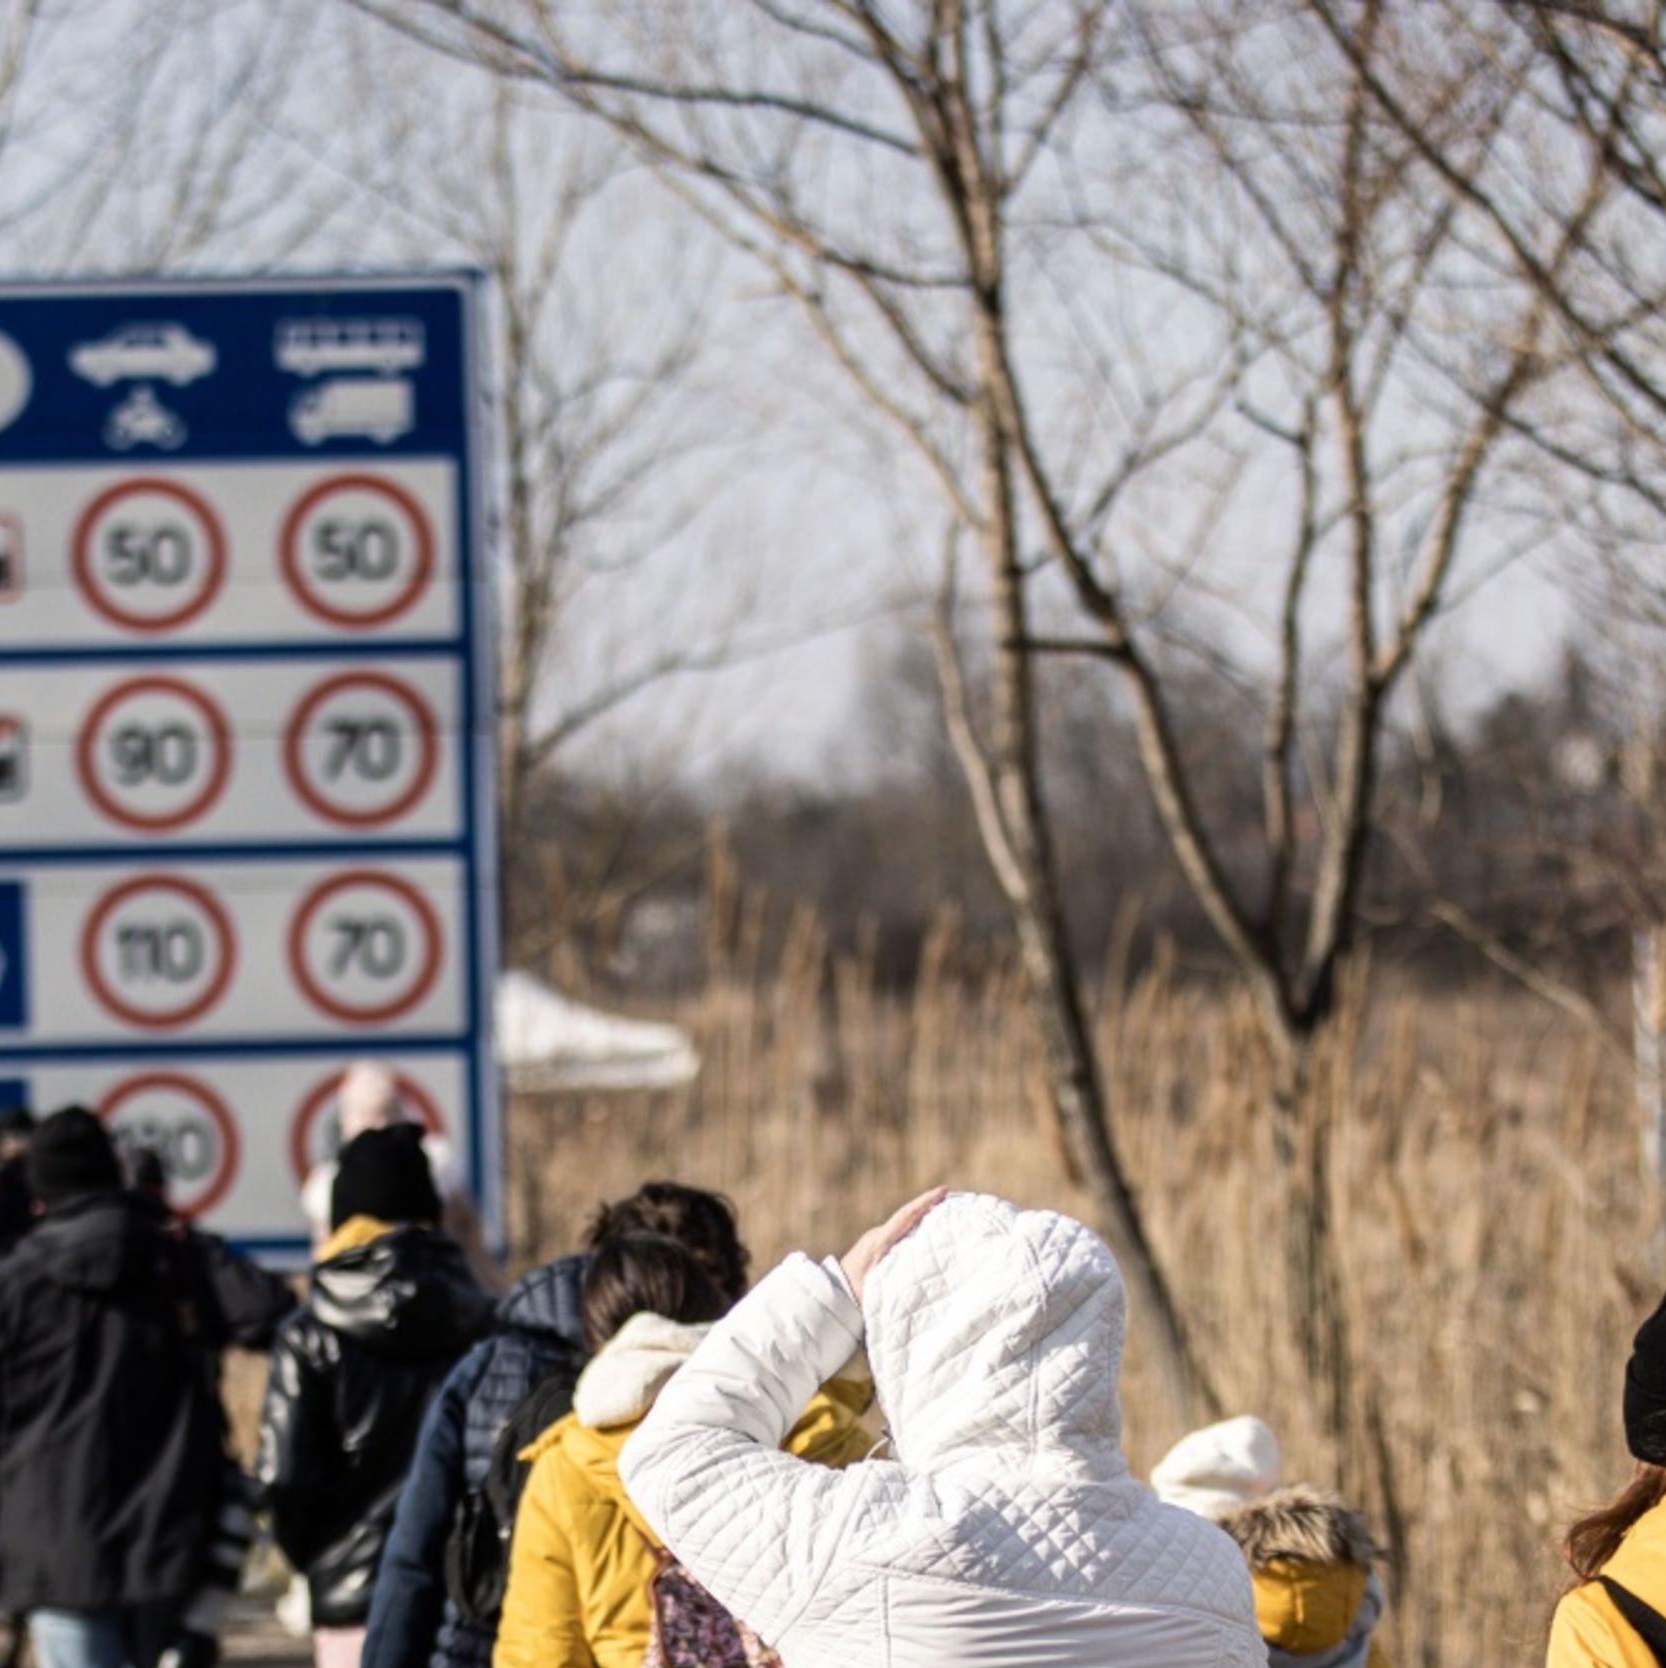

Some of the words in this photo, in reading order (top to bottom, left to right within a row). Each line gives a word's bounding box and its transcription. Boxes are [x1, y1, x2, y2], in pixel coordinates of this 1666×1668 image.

[105, 525, 191, 587] 50
[311, 519, 398, 583] 50
[112, 724, 197, 787] 90
[324, 718, 401, 783] 70
[116, 919, 204, 983] 110
[327, 916, 405, 981] 70
